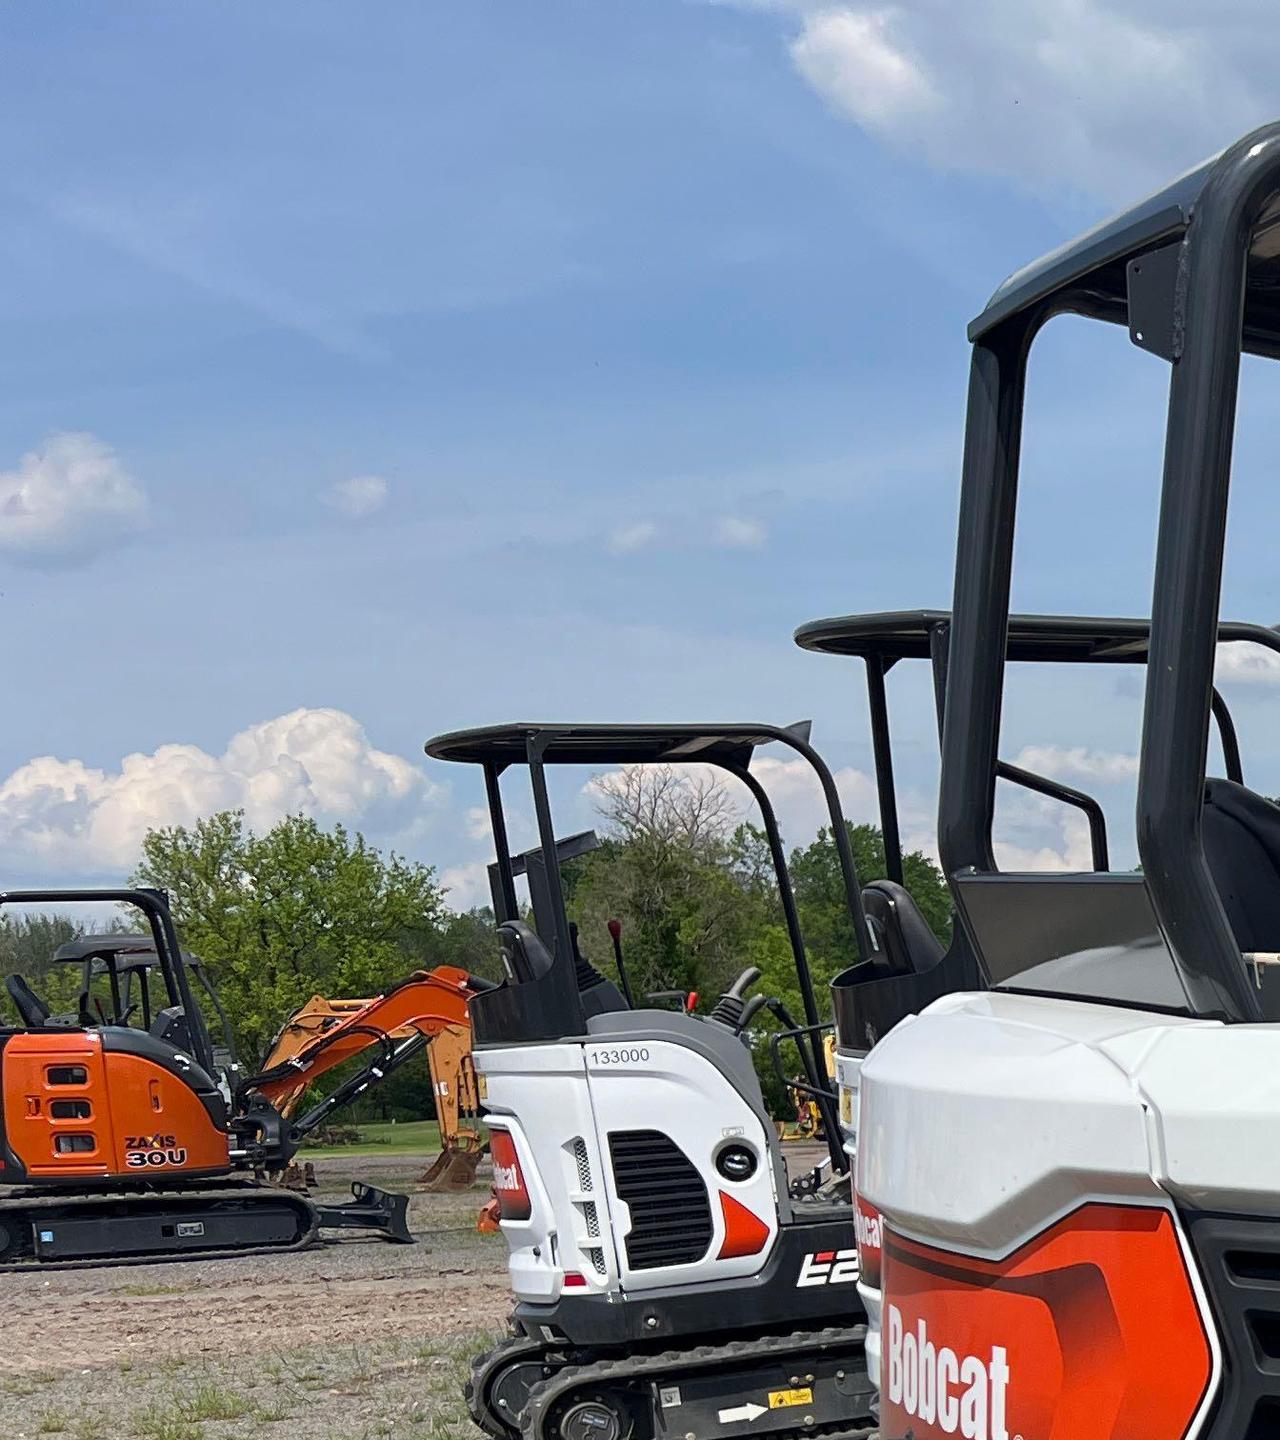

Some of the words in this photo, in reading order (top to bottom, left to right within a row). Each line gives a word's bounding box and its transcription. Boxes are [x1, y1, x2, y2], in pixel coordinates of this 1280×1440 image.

[591, 1047, 650, 1066] 133000
[124, 1132, 177, 1149] ZAXIS
[125, 1147, 188, 1169] 30U
[795, 1248, 860, 1288] E2
